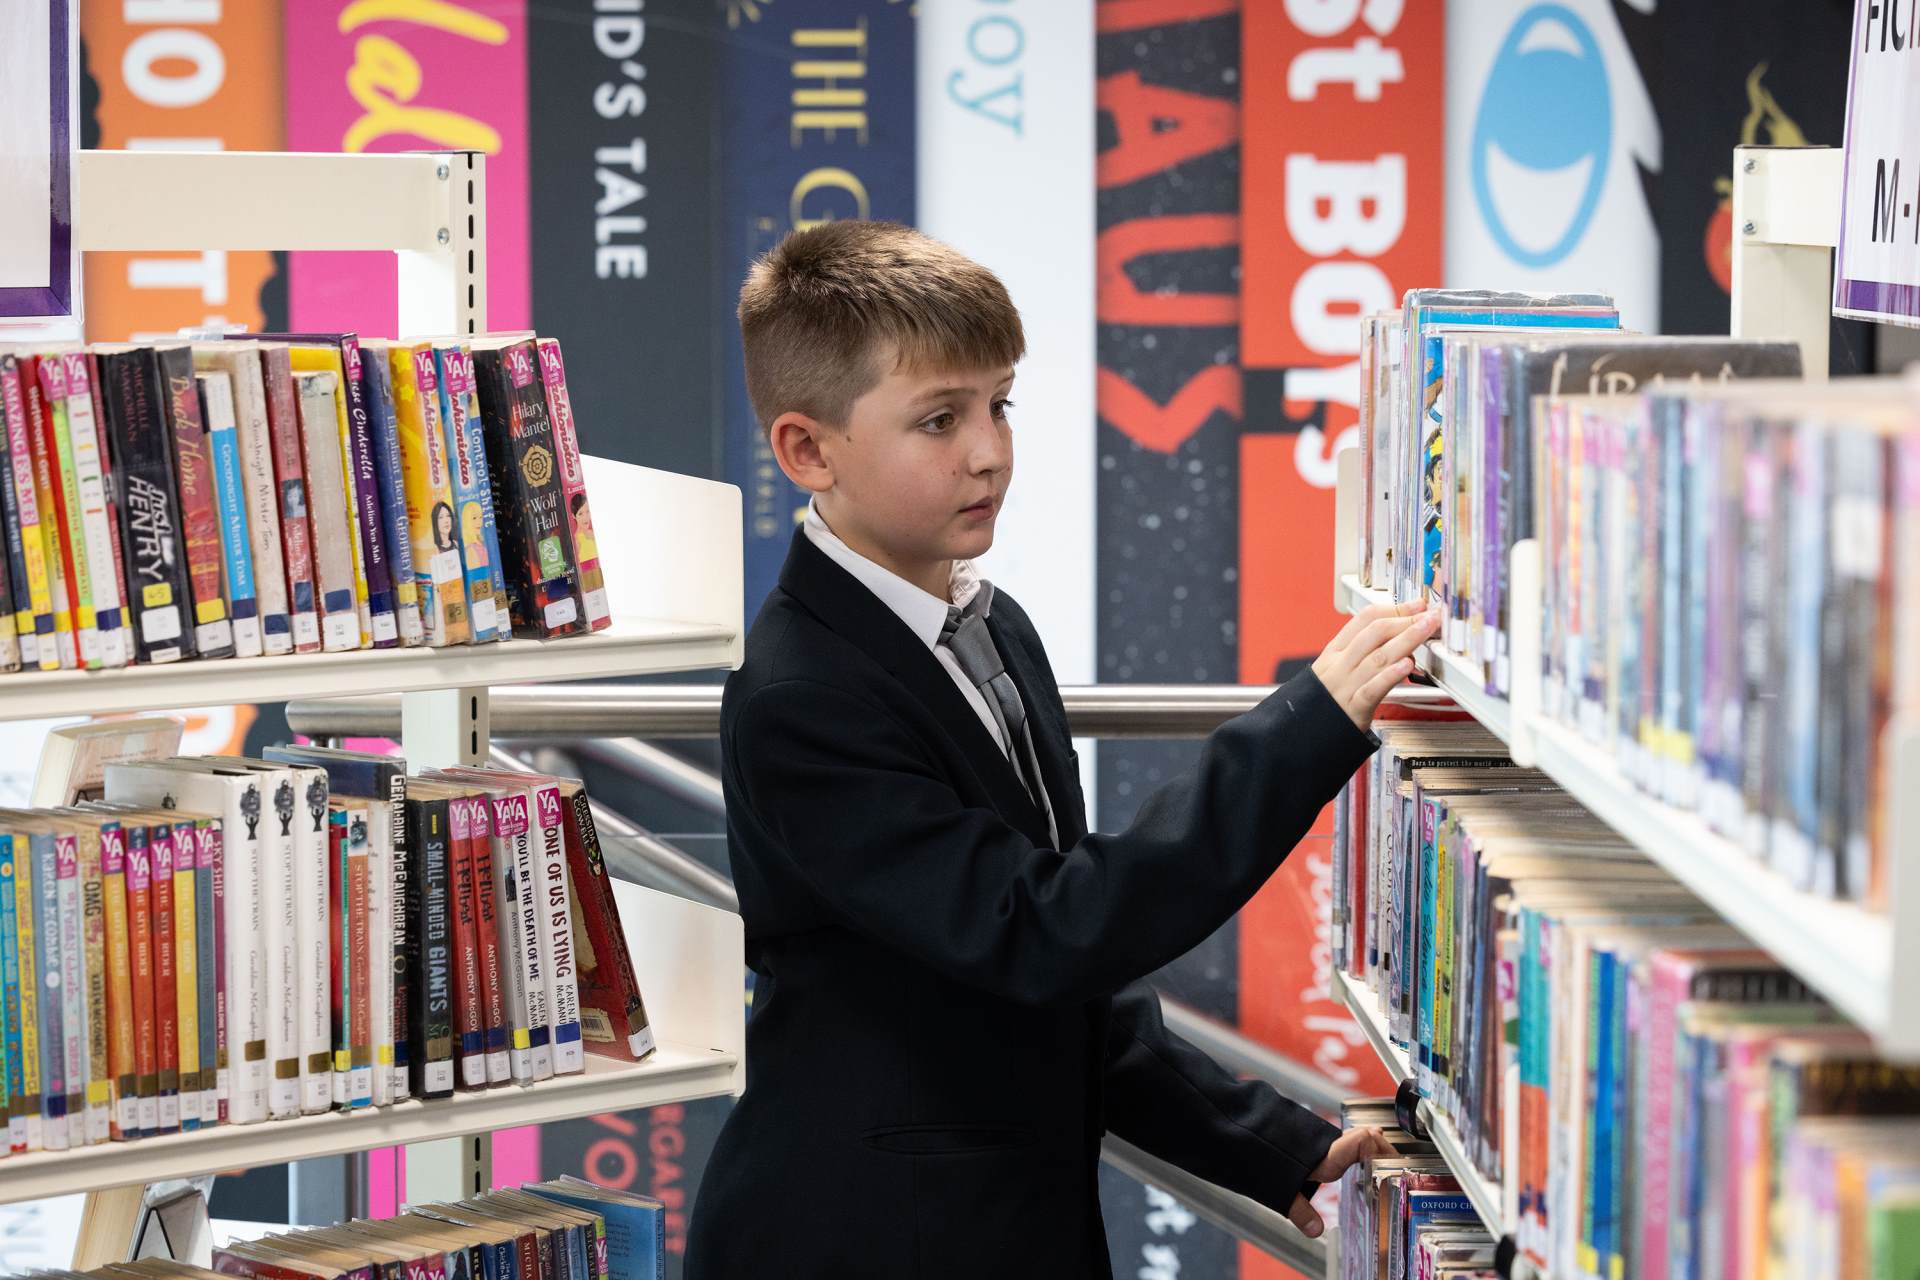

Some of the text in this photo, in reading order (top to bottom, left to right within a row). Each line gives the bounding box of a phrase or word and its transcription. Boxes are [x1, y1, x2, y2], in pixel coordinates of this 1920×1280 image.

[791, 18, 869, 147] THE
[946, 0, 1025, 138] oy
[594, 138, 648, 280] TALE
[65, 355, 88, 381] YA
[416, 353, 435, 377] YA
[444, 355, 464, 379] YA
[509, 350, 529, 374] YA
[541, 349, 560, 371] YA
[121, 363, 138, 442] MAGORIAN
[134, 365, 149, 431] MICHELLE
[511, 400, 544, 421] Hilary
[5, 376, 27, 452] AMAZING
[513, 415, 551, 442] Mantel
[170, 375, 202, 496] Back Home
[352, 407, 374, 481] Cinderella
[386, 415, 400, 474] Elephant
[14, 454, 38, 525] ESME
[530, 491, 558, 513] Wolf
[364, 493, 375, 525] Adeline
[535, 511, 559, 533] Hall
[128, 475, 164, 581] HENRY
[368, 526, 378, 543] Yen
[371, 544, 381, 565] Mah
[1428, 759, 1435, 767] to
[1436, 759, 1460, 768] protect
[1461, 759, 1472, 767] the
[390, 774, 408, 846] GERALDINE
[451, 803, 469, 826] YA
[468, 800, 488, 823] YA
[493, 800, 511, 824] YA
[508, 798, 526, 821] YA
[538, 791, 560, 814] YA
[572, 799, 590, 846] COWELL
[578, 794, 596, 844] CRESSIDA
[1424, 805, 1434, 831] YA
[56, 839, 76, 865] YA
[102, 834, 124, 857] YA
[153, 844, 172, 867] YA
[173, 830, 194, 854] YA
[195, 829, 214, 853] YA
[212, 840, 222, 866] SKY
[316, 840, 325, 869] STOP
[128, 852, 150, 876] YA
[251, 848, 260, 877] STOP
[284, 843, 293, 873] STOP
[213, 868, 223, 898] SHIP
[251, 880, 260, 900] THE
[284, 876, 293, 895] THE
[317, 871, 325, 890] THE
[354, 864, 365, 893] STOP
[427, 841, 446, 941] SMALL-MINDED
[84, 881, 101, 918] OMG
[285, 897, 294, 926] TRAIN
[317, 891, 326, 922] TRAIN
[355, 894, 365, 918] THE
[517, 831, 541, 982] YOU'LL BE THE DEATH OF ME
[544, 825, 572, 979] ONE OF US IS LYING
[137, 911, 148, 940] KITE
[159, 911, 169, 938] KITE
[252, 901, 260, 931] TRAIN
[355, 920, 366, 953] TRAIN
[138, 943, 149, 977] RIDER
[161, 942, 171, 977] RIDER
[487, 943, 499, 992] ANTHONY
[510, 911, 524, 998] Anthony McGowan
[429, 945, 448, 1013] GIANTS
[464, 946, 476, 995] ANTHONY
[536, 990, 548, 1022] KAREN
[556, 985, 568, 1025] McMANU
[564, 984, 577, 1015] KAREN
[1421, 1201, 1458, 1210] OXFORD
